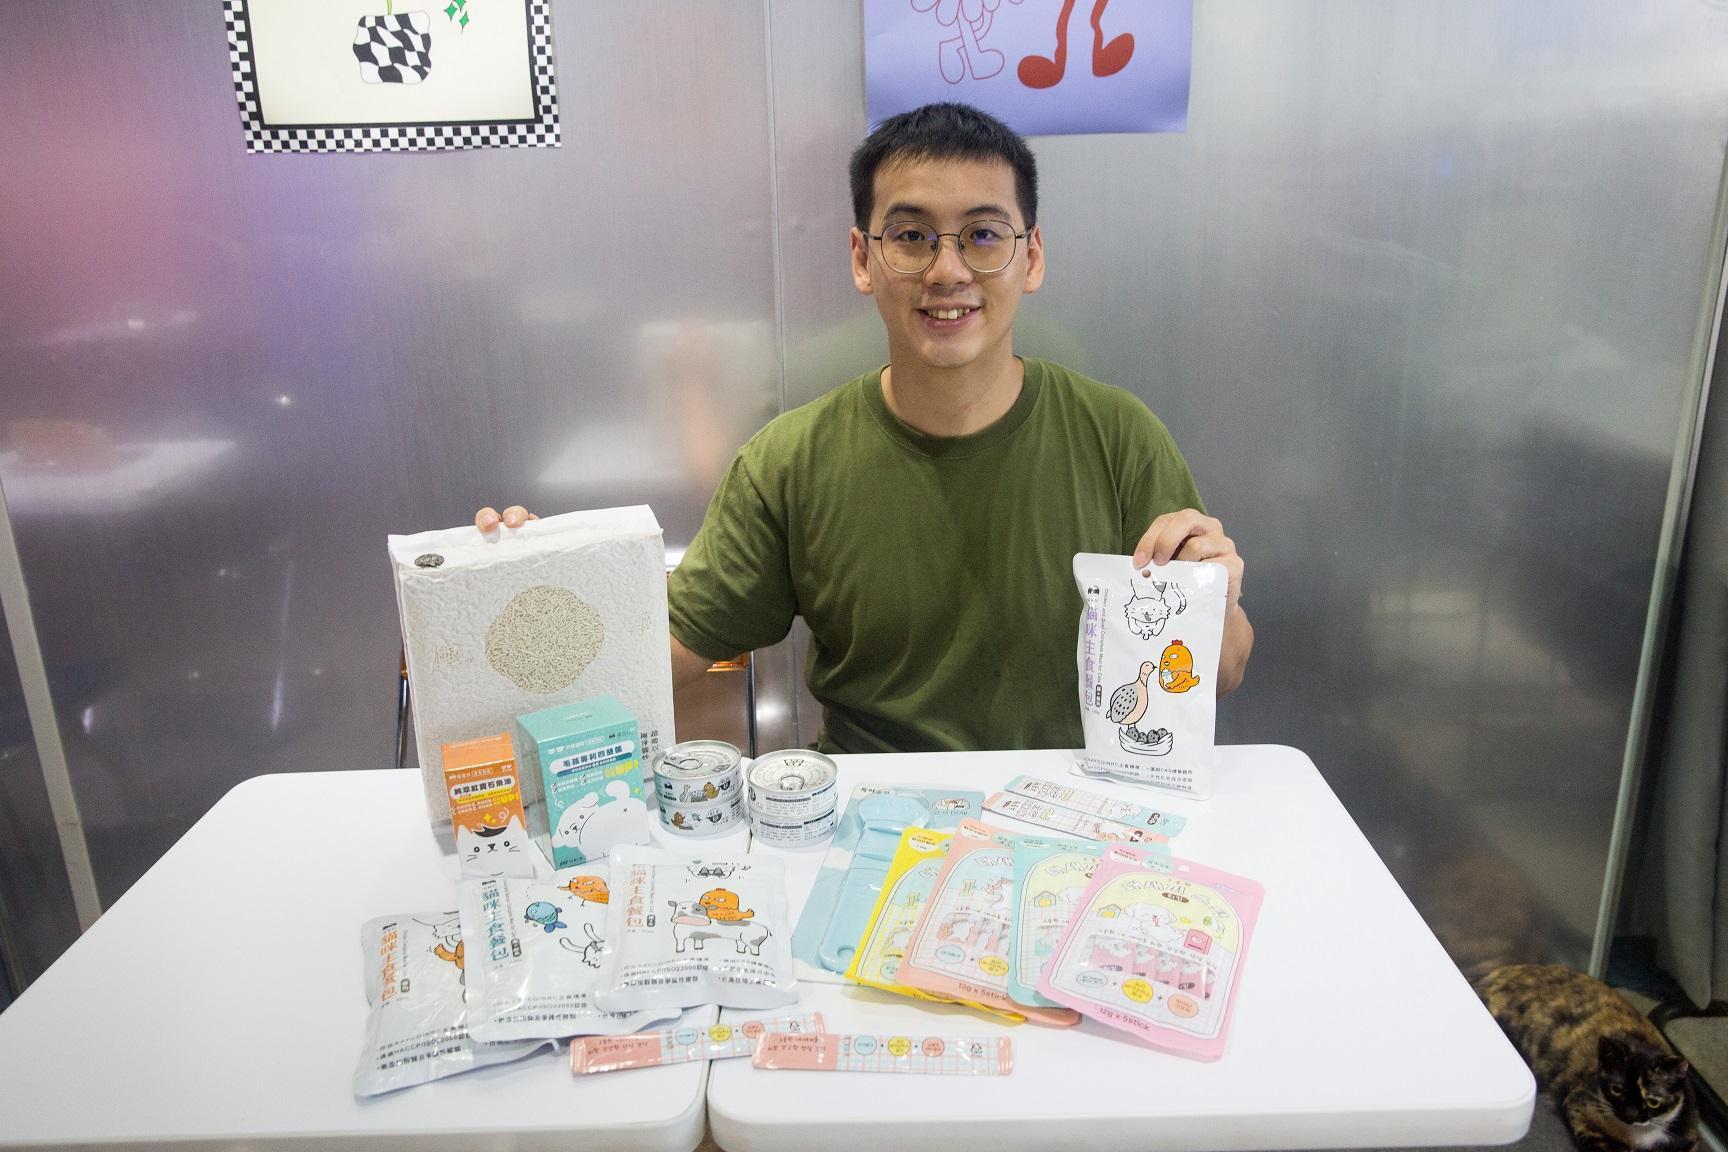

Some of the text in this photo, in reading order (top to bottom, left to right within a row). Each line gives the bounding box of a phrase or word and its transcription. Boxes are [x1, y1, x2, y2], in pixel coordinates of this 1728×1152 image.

[481, 888, 509, 961] 貓咪主食餐包
[1100, 1007, 1113, 1018] 12g
[1123, 1014, 1151, 1032] 5stick
